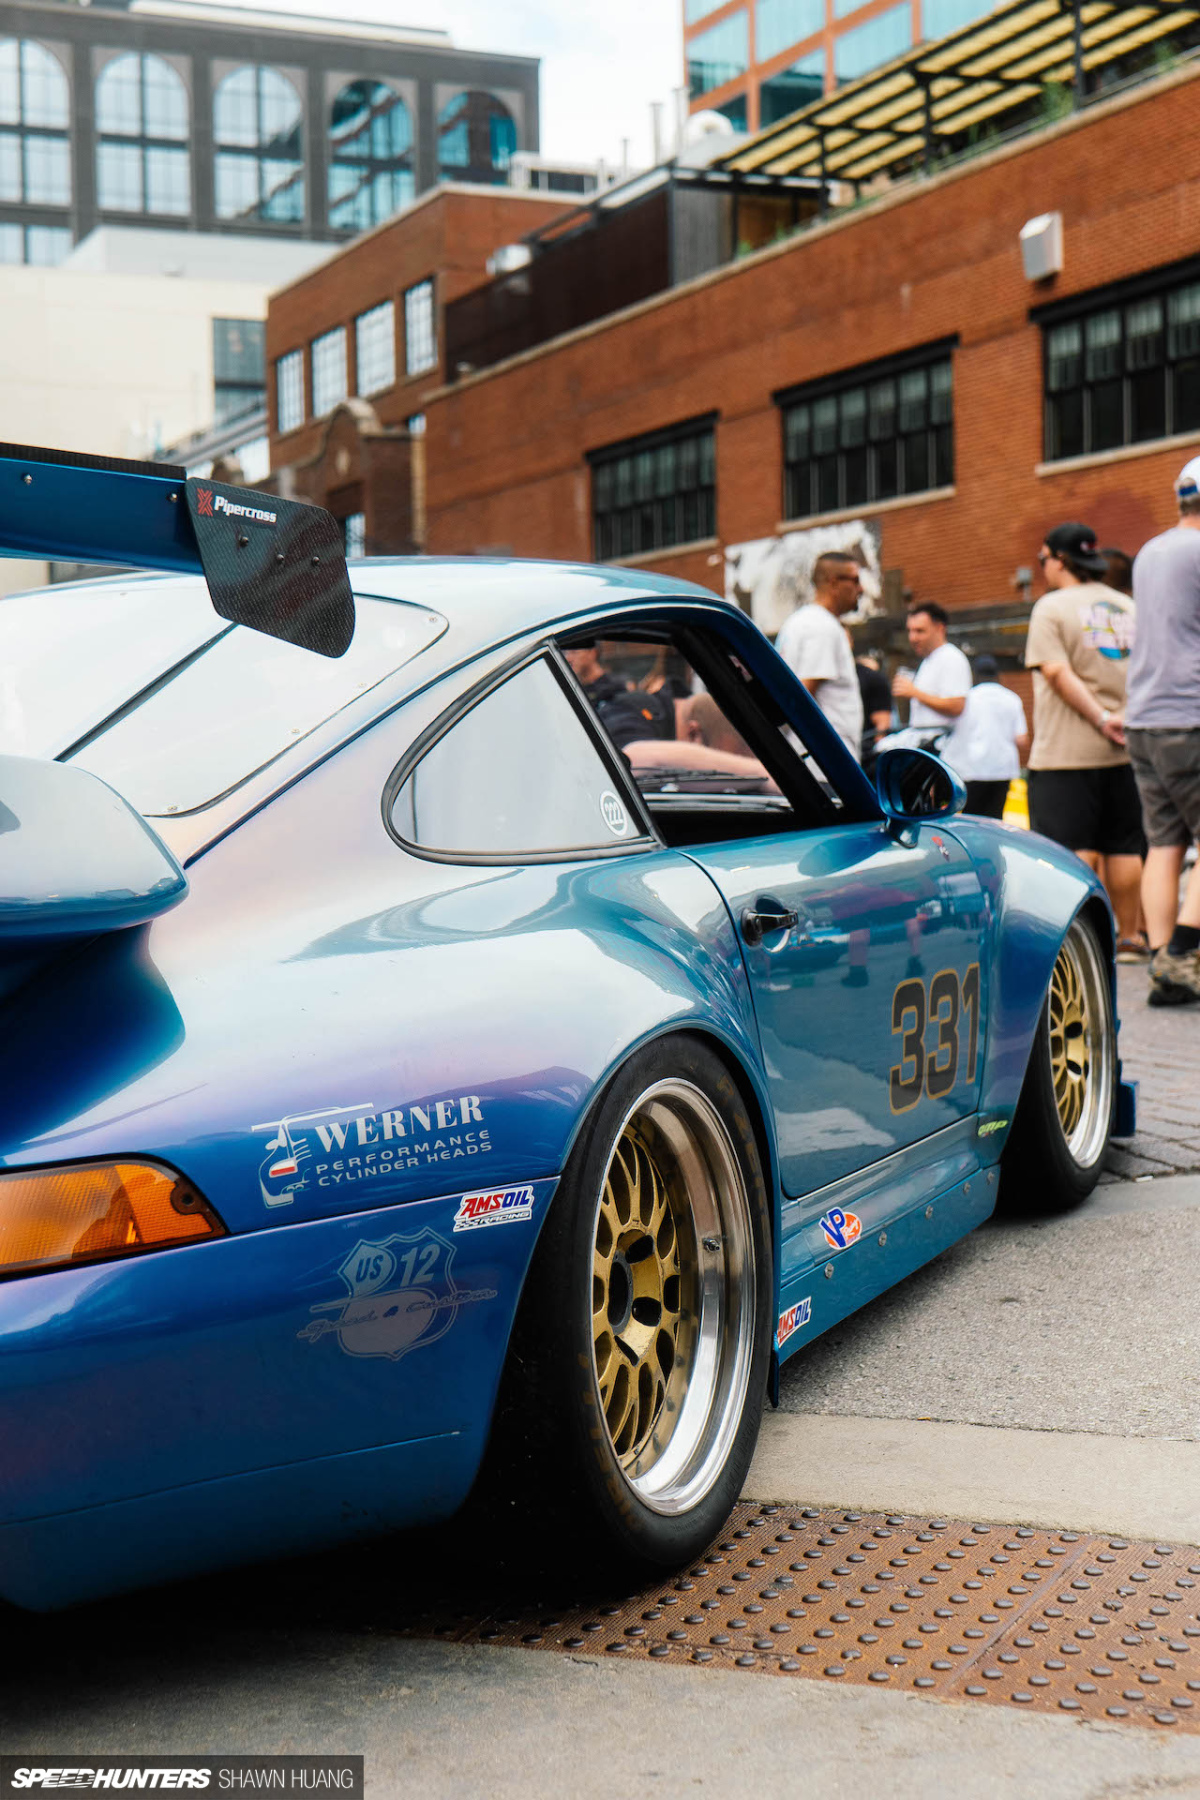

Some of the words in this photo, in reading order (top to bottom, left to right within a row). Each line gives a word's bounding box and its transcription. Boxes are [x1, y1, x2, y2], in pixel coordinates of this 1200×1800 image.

[214, 495, 277, 523] Pipercross
[890, 962, 980, 1116] 331
[314, 1095, 484, 1153] WERNER
[316, 1129, 490, 1175] PERFORMANCE
[318, 1157, 419, 1186] CYLINDER
[427, 1141, 492, 1164] HEADS
[460, 1189, 530, 1219] AMSOIL
[480, 1212, 529, 1226] RACING
[820, 1208, 845, 1248] VP
[355, 1255, 384, 1283] US
[400, 1243, 441, 1287] 12
[777, 1301, 811, 1346] AMSOIL
